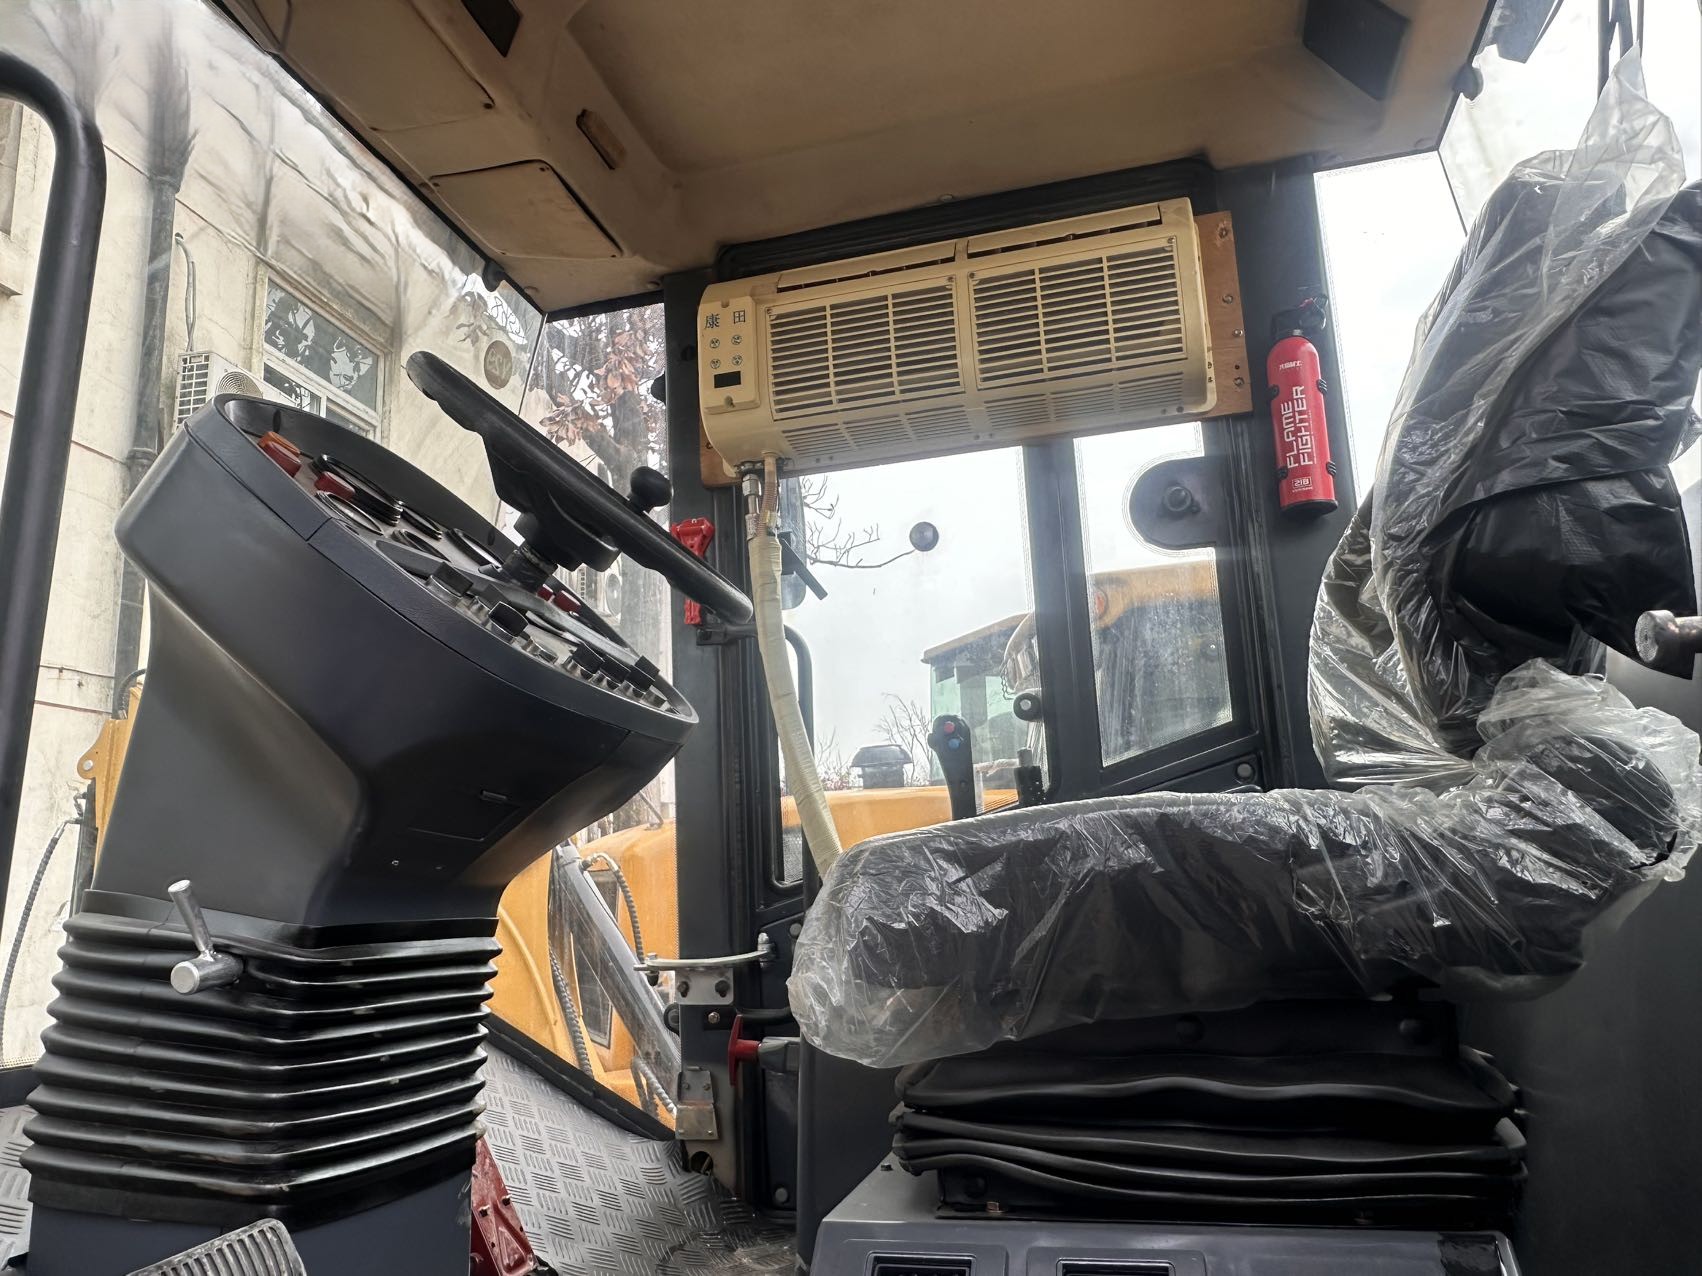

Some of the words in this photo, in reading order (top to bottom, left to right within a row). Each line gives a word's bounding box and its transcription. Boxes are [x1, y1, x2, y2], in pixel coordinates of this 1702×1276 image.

[704, 309, 746, 329] 康田
[1281, 401, 1299, 469] FLAME
[1292, 385, 1314, 466] FIGHTER
